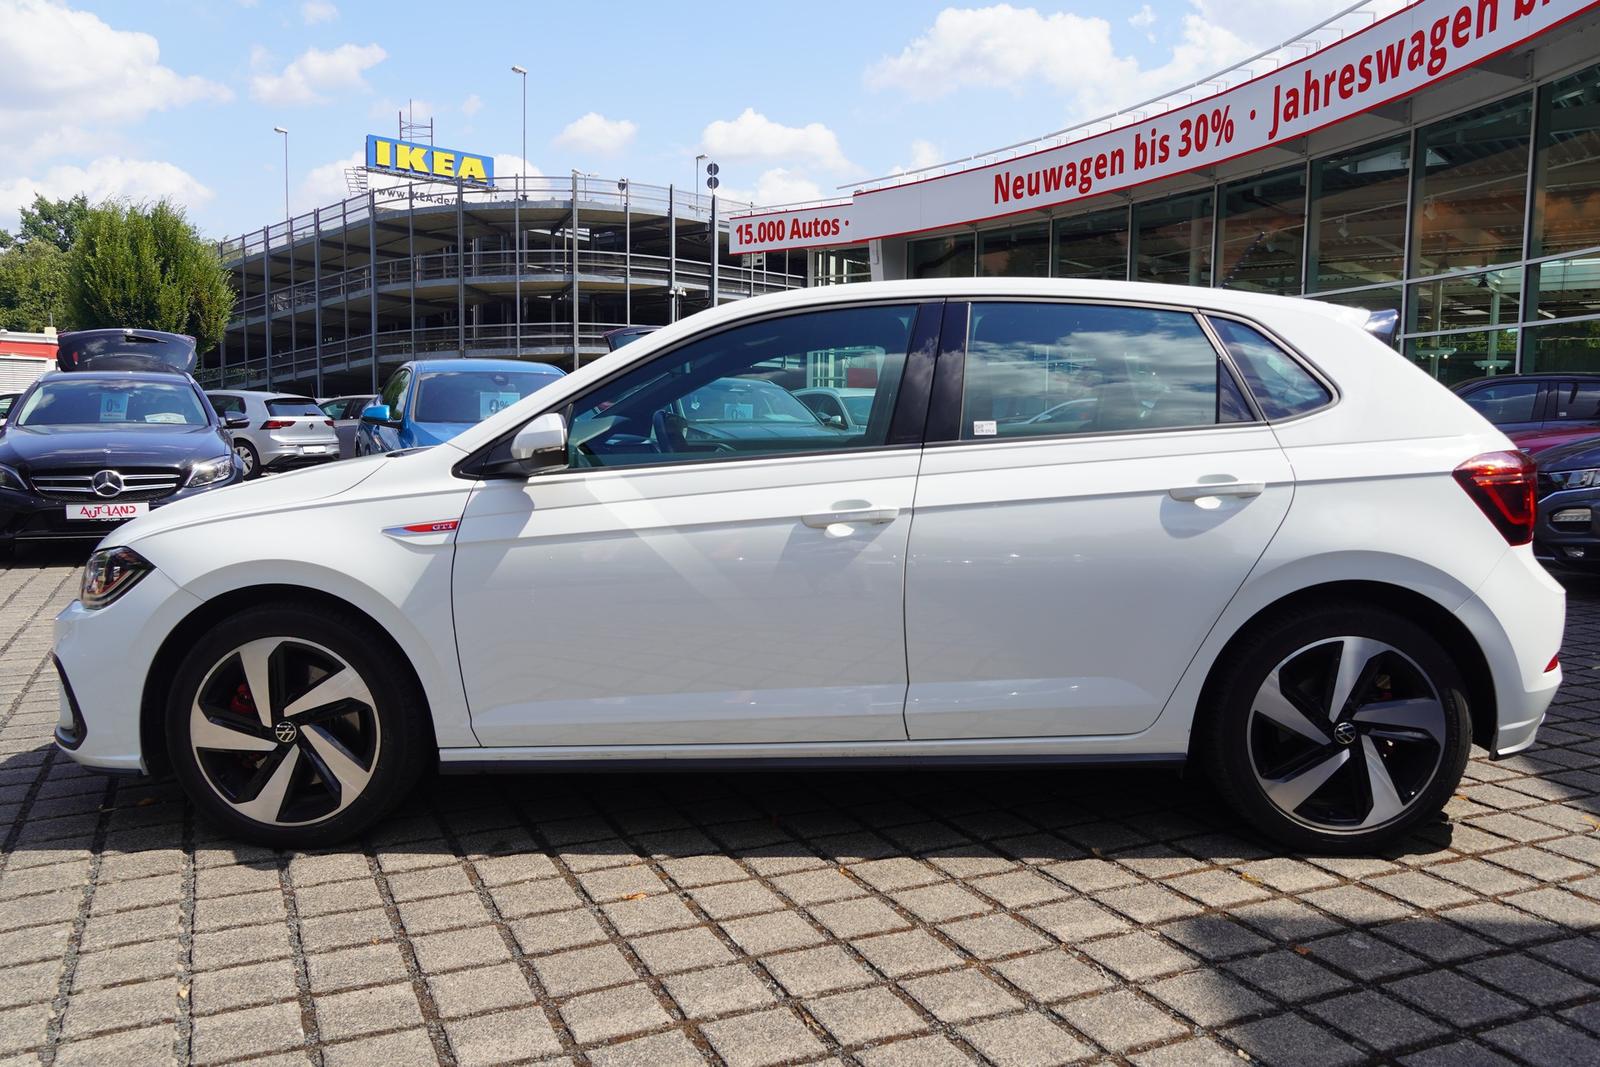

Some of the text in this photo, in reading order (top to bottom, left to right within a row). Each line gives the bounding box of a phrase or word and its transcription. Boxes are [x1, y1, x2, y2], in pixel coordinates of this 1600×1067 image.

[736, 219, 785, 245] 15.000
[789, 217, 840, 240] Autos
[994, 147, 1124, 204] Neuwagen
[1134, 128, 1170, 170] bis
[1178, 105, 1234, 157] 30%
[1268, 0, 1499, 140] Jahreswagen
[376, 140, 488, 183] IKEA
[80, 504, 136, 518] AUTOLAND
[432, 523, 453, 531] GTI
